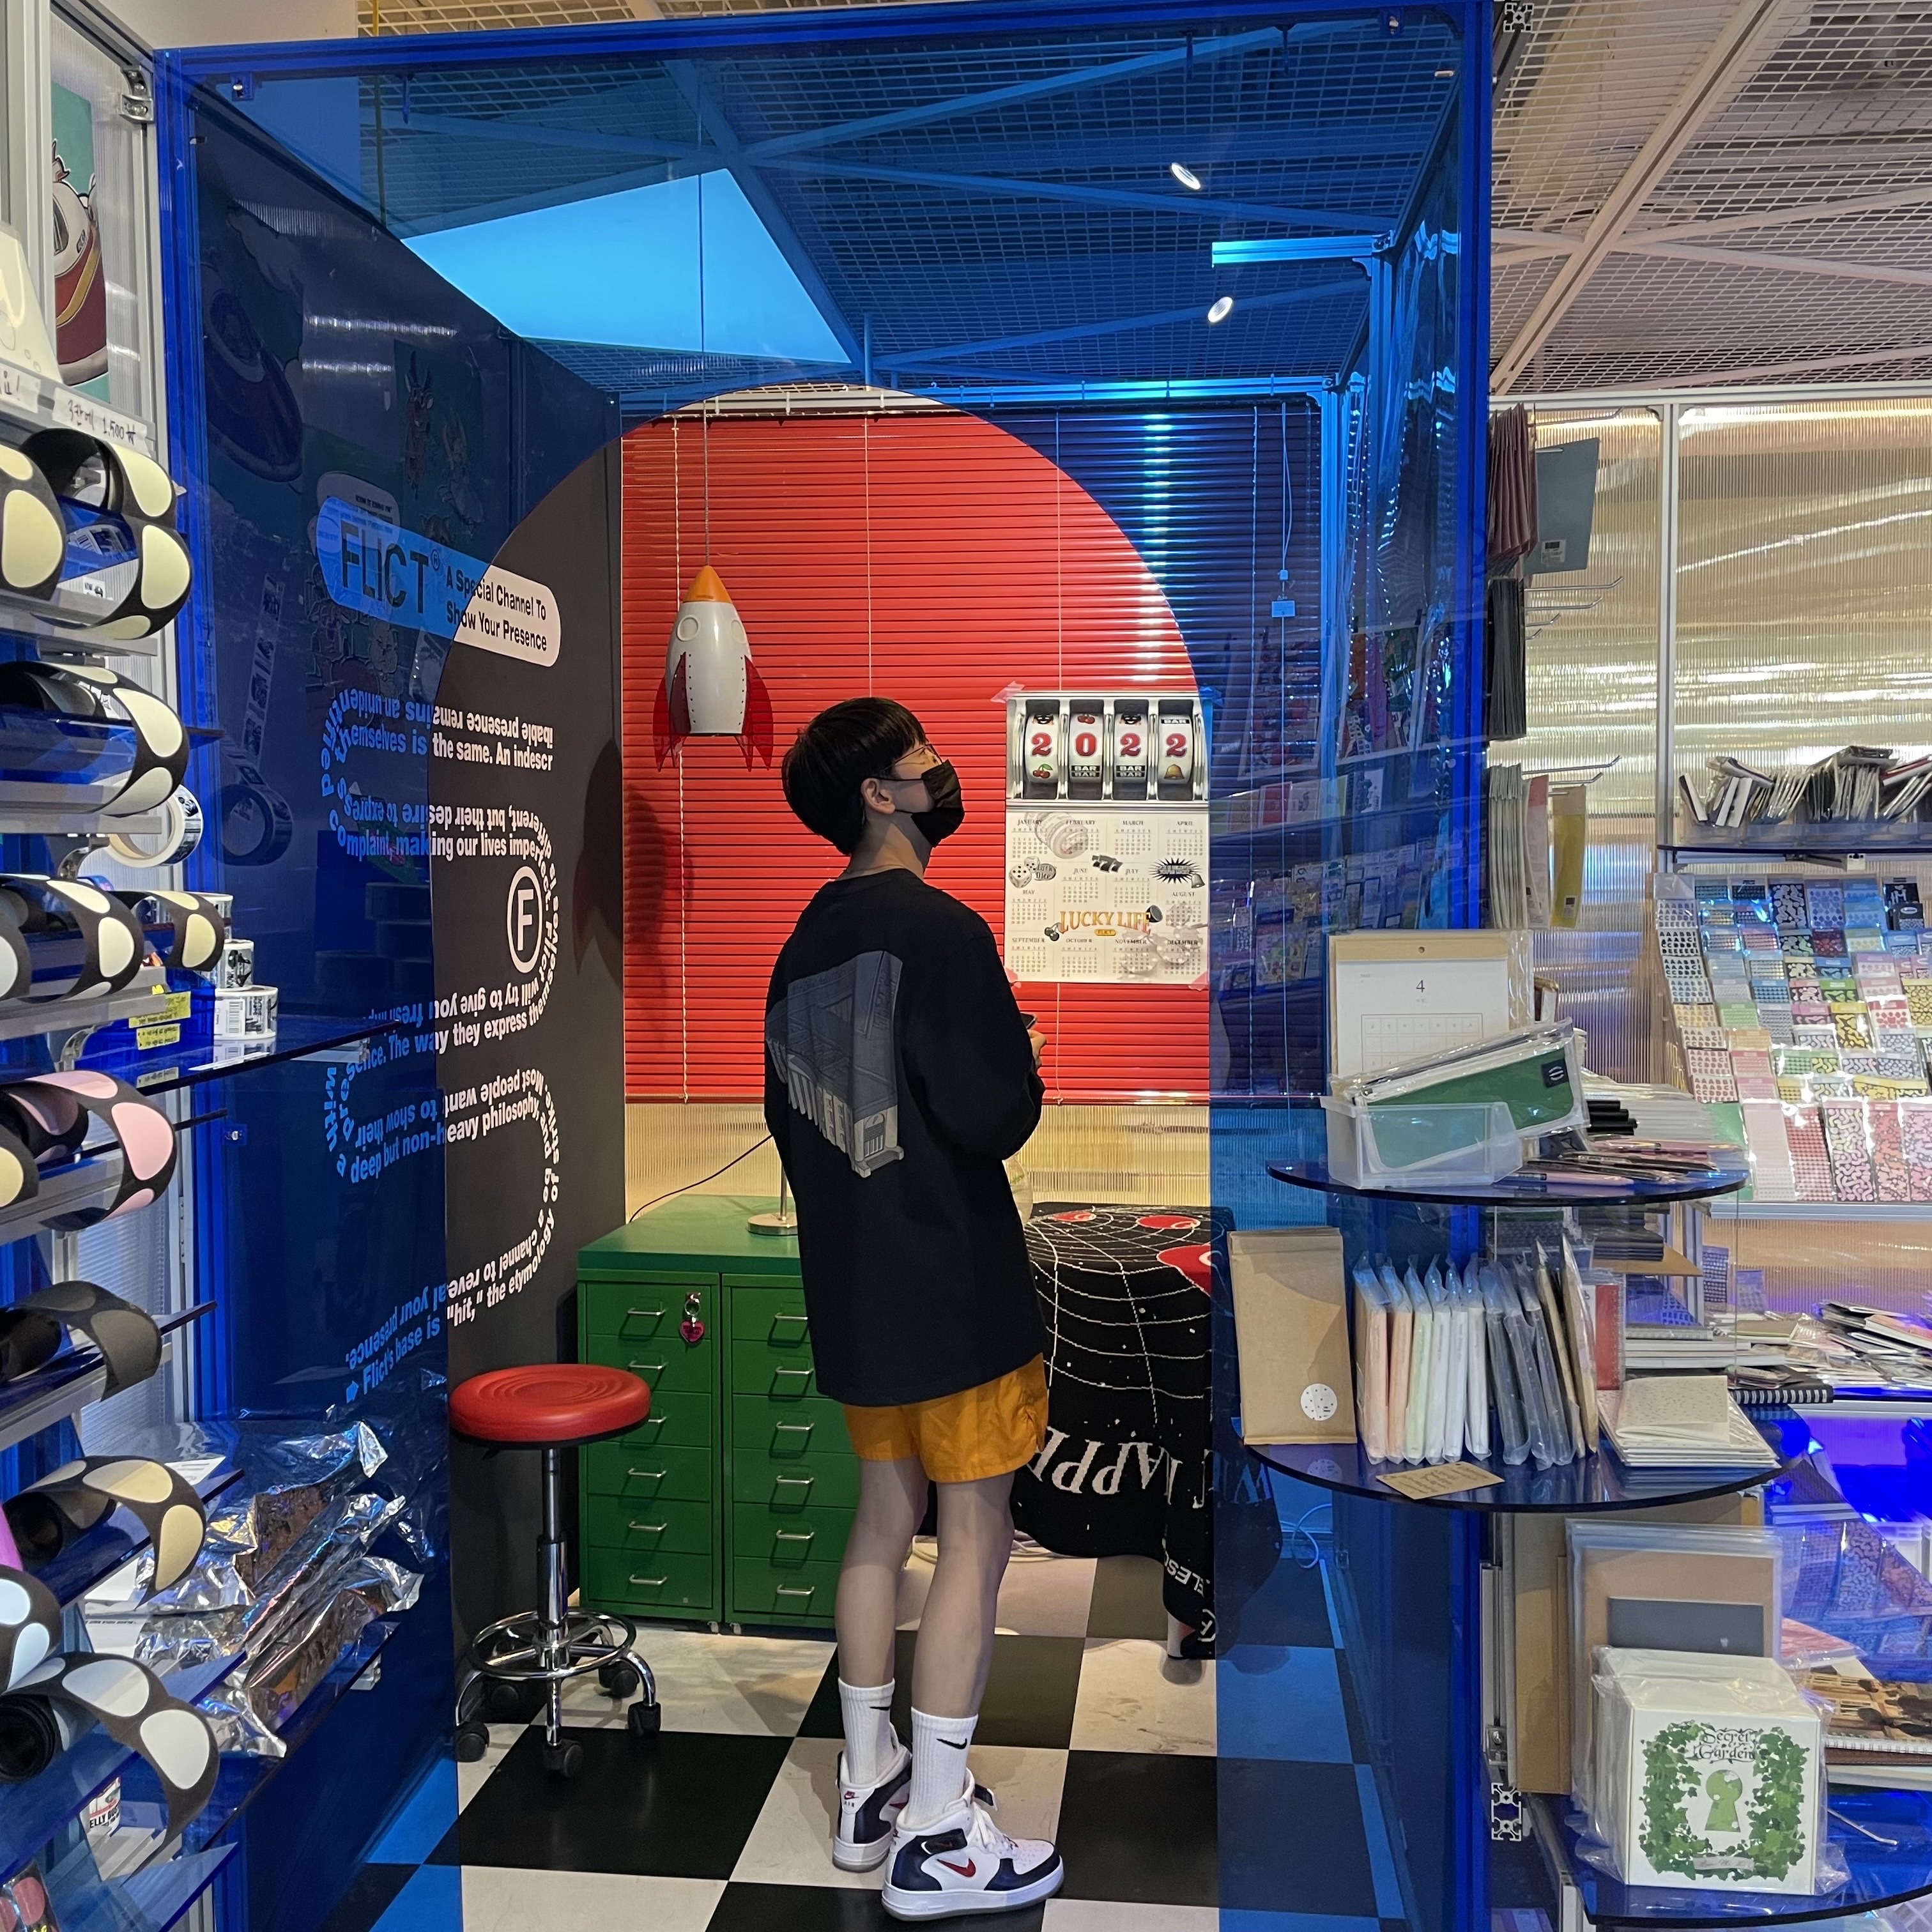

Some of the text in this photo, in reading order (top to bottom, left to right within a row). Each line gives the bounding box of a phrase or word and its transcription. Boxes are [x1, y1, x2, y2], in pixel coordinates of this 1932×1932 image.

[447, 565, 546, 621] A Special Channel To
[446, 600, 548, 652] Show Your Presence
[385, 696, 401, 719] an
[404, 700, 464, 730] remains
[466, 712, 519, 739] presence
[521, 723, 554, 749] ibable
[335, 724, 553, 771] themselves is the same. An indescr
[337, 776, 385, 823] express
[386, 802, 397, 828] to
[401, 803, 452, 829] desire
[454, 806, 484, 832] their
[487, 808, 506, 833] but
[395, 829, 454, 862] making
[456, 838, 479, 857] our
[480, 832, 507, 857] lives
[509, 832, 552, 912] imperfect.
[1059, 910, 1116, 935] LUCKY
[1117, 910, 1152, 935] LIFE
[388, 895, 560, 1061] The way they express themselves
[521, 977, 540, 1008] will
[1416, 979, 1425, 993] 4
[460, 987, 486, 1018] give
[489, 990, 503, 1011] to
[504, 987, 519, 1013] try
[480, 1068, 521, 1105] people
[522, 1068, 545, 1098] Most
[386, 1103, 416, 1131] show
[420, 1099, 438, 1119] to
[443, 1089, 478, 1119] want
[350, 1151, 382, 1184] deep
[383, 1135, 400, 1168] but
[402, 1115, 480, 1157] non-heavy
[482, 1091, 540, 1137] philosophy,
[355, 1117, 385, 1152] their
[500, 1229, 538, 1278] channel
[395, 1330, 422, 1365] base
[426, 1314, 441, 1340] is
[486, 1281, 507, 1308] the
[508, 1208, 556, 1295] etymology
[483, 1262, 497, 1283] to
[433, 1268, 480, 1312] reveal
[399, 1285, 429, 1326] your
[1698, 1744, 1755, 1759] Garden
[1702, 1731, 1749, 1744] Secret
